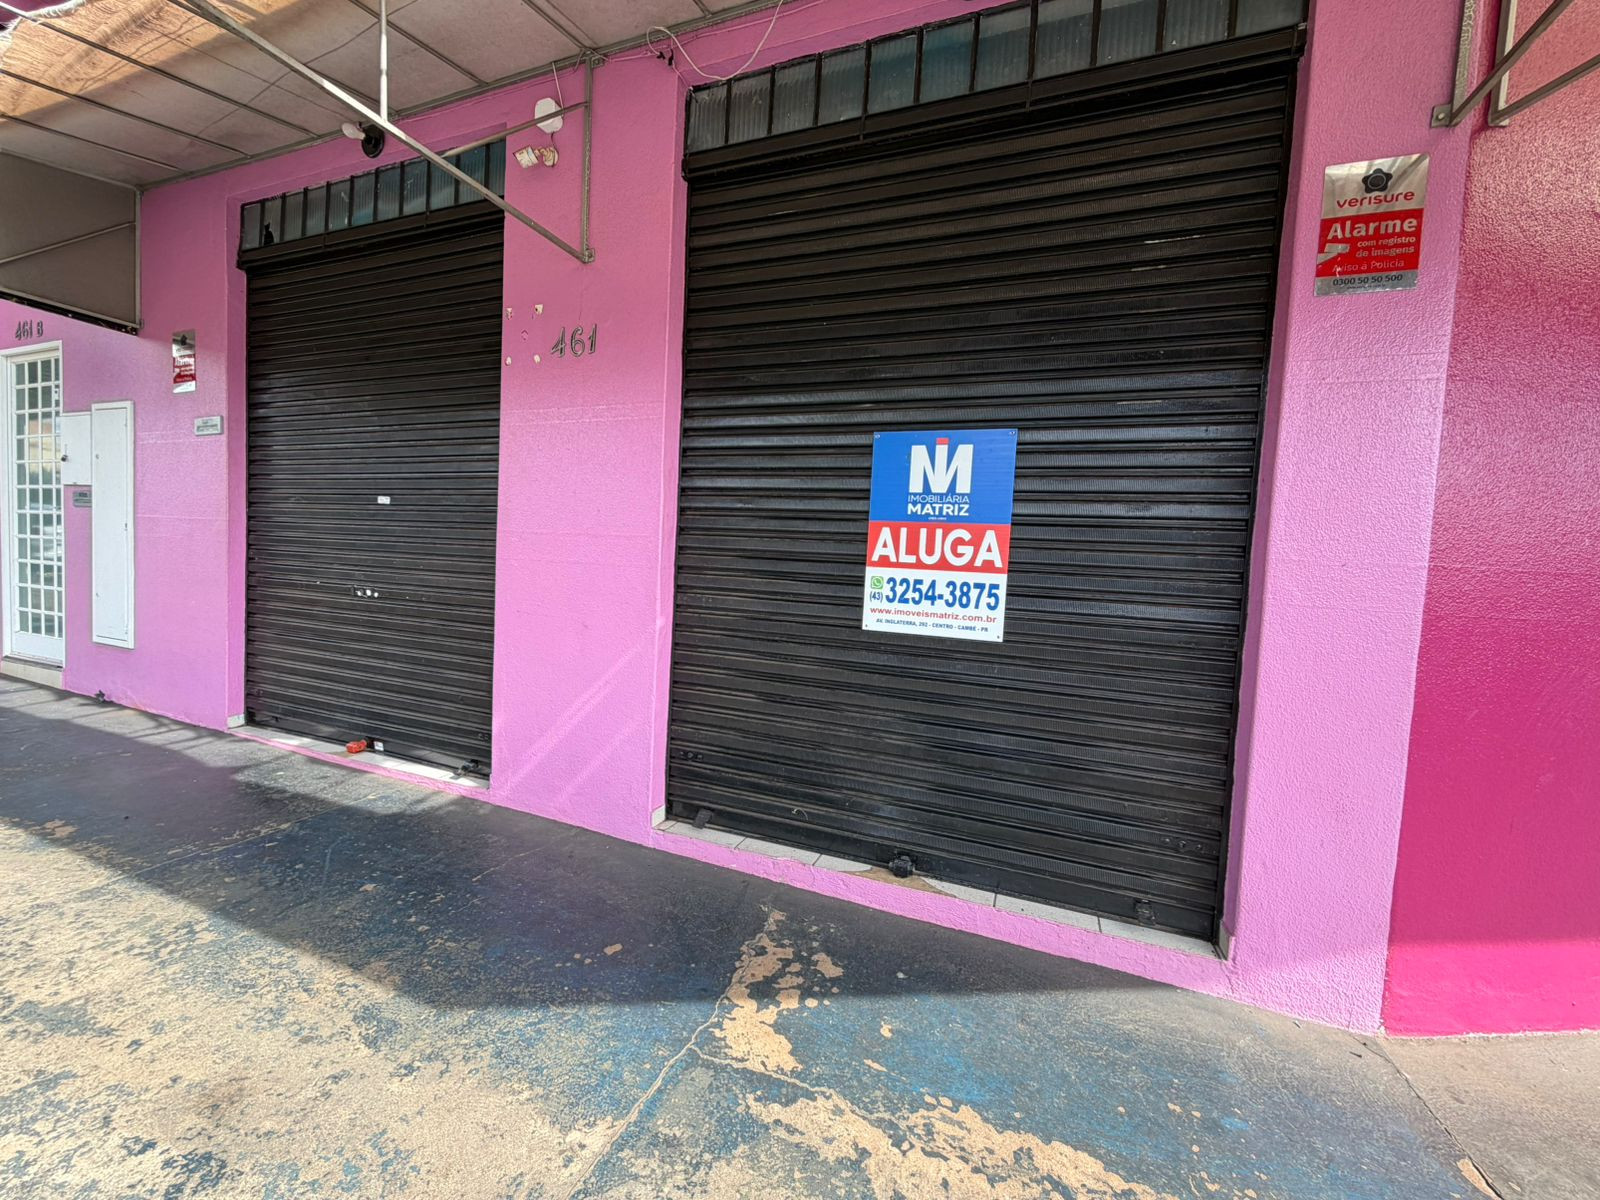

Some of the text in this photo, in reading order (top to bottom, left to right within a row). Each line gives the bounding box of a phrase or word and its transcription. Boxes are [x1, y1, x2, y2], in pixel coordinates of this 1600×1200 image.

[1336, 191, 1415, 208] verisure
[1327, 218, 1417, 239] Alarme
[1357, 235, 1416, 248] com registro
[1355, 246, 1415, 258] de imagens
[1332, 278, 1356, 287] 0300
[1357, 276, 1369, 284] 50
[1371, 275, 1383, 283] 50
[1384, 273, 1403, 282] 500
[15, 319, 33, 341] 461
[550, 323, 597, 358] 461
[907, 493, 971, 504] IMOBILIÁRIA
[907, 503, 970, 516] MATRIZ
[871, 526, 1003, 568] ALUGA
[868, 576, 1000, 611] (43) 3254-3875
[870, 607, 997, 623] www.imoveismatriz.com.br
